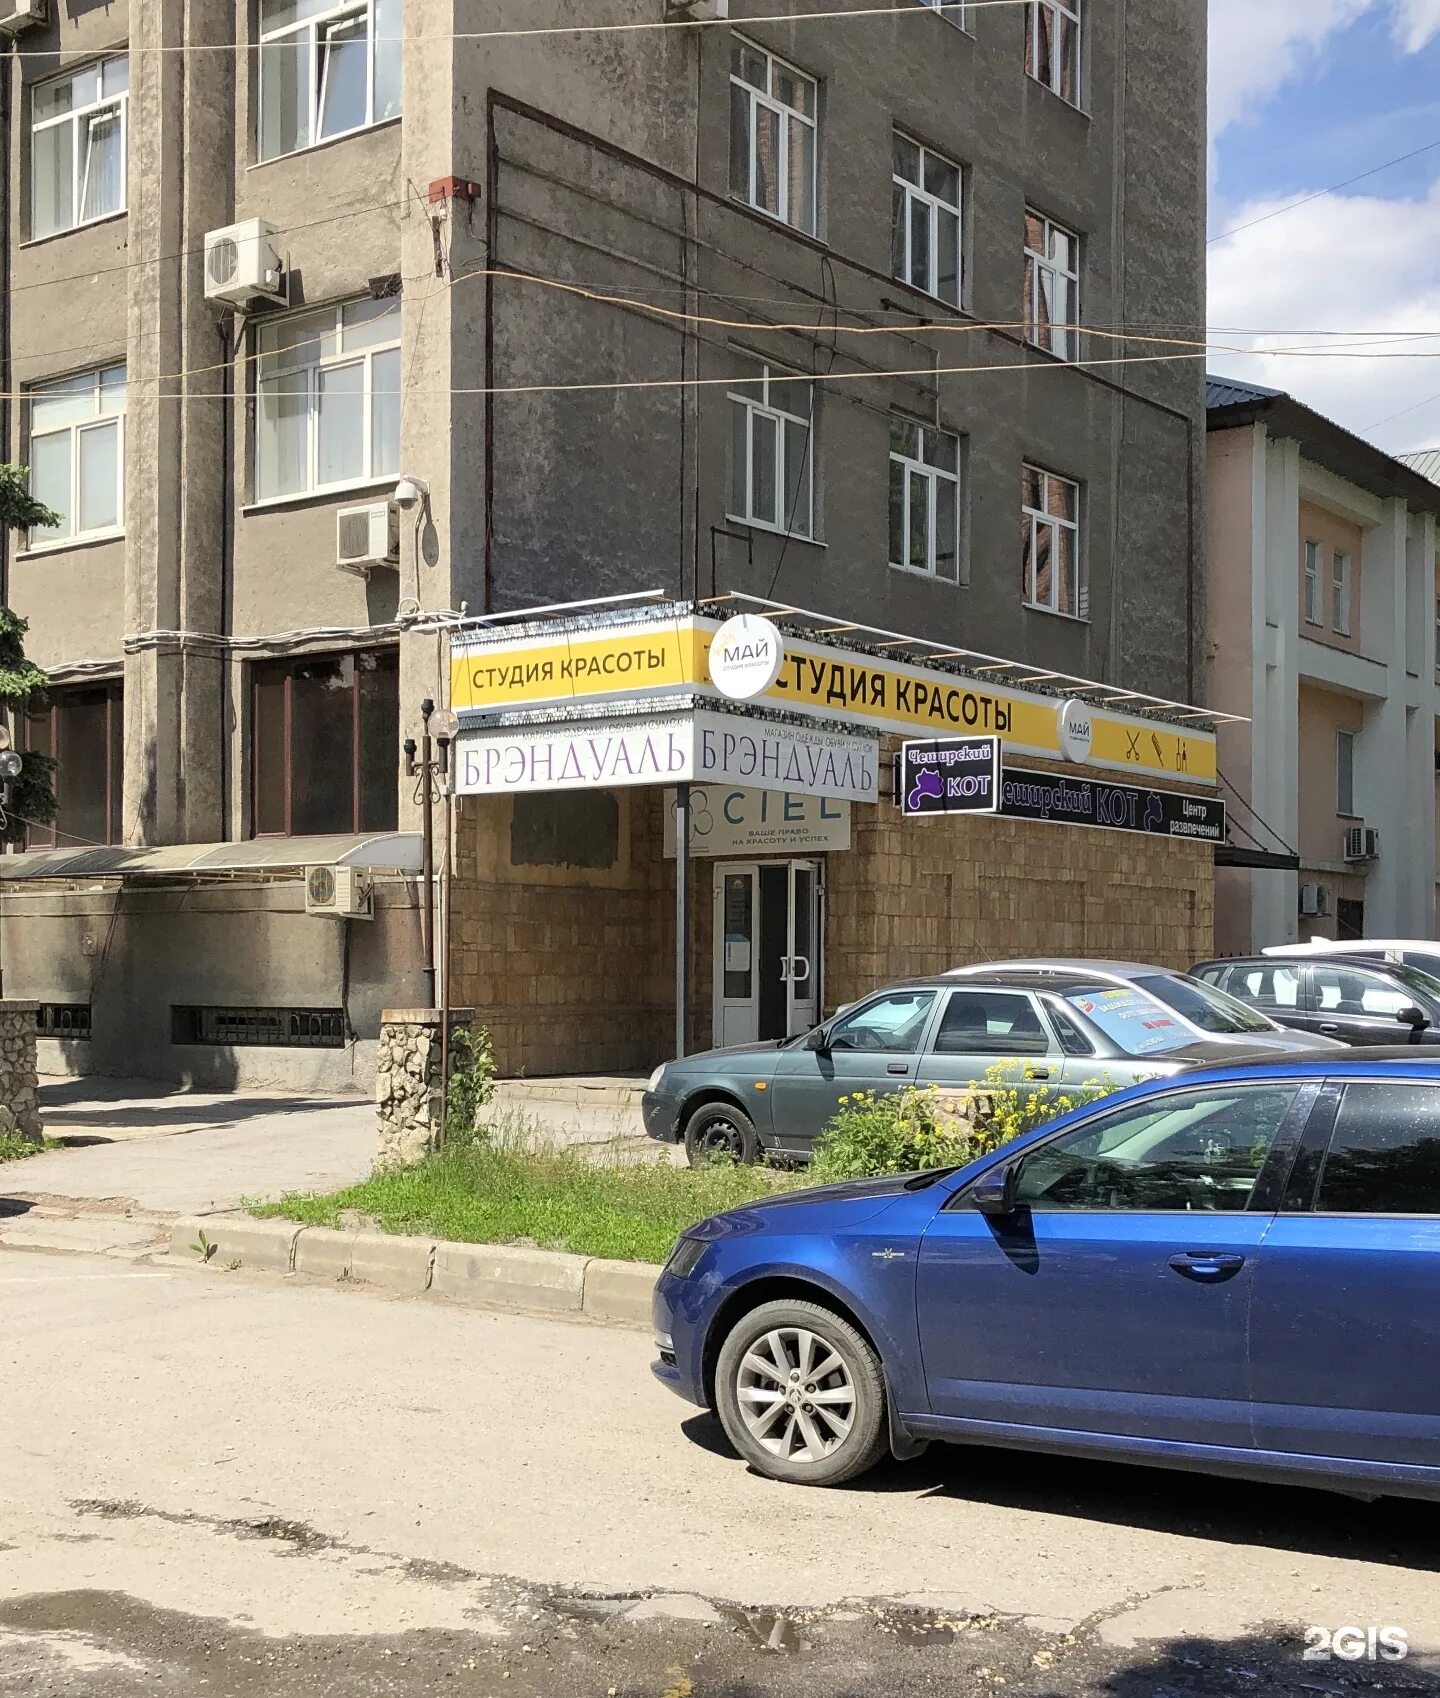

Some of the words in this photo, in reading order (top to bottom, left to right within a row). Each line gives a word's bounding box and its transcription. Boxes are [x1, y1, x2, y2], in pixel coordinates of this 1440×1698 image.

[724, 638, 768, 662] МАЙ
[472, 661, 553, 689] СТУДИЯ
[560, 647, 665, 680] КРАСОТЫ
[896, 678, 1012, 733] КРАСОТЫ
[764, 727, 795, 740] МАГАЗИН
[1069, 721, 1090, 737] МАЙ
[463, 733, 685, 787] БРЭНДУАЛЬ
[701, 729, 873, 791] БРЭНДУАЛЬ
[908, 744, 991, 766] Чеширский
[947, 775, 991, 797] КОТ
[723, 790, 842, 825] CIEL
[1001, 780, 1092, 818] еширский
[1096, 787, 1139, 827] КОТ
[1182, 799, 1207, 820] Центр
[746, 837, 787, 845] КРАСОТУ
[799, 835, 829, 843] УСПЕХ
[748, 829, 776, 837] ВАШЕ
